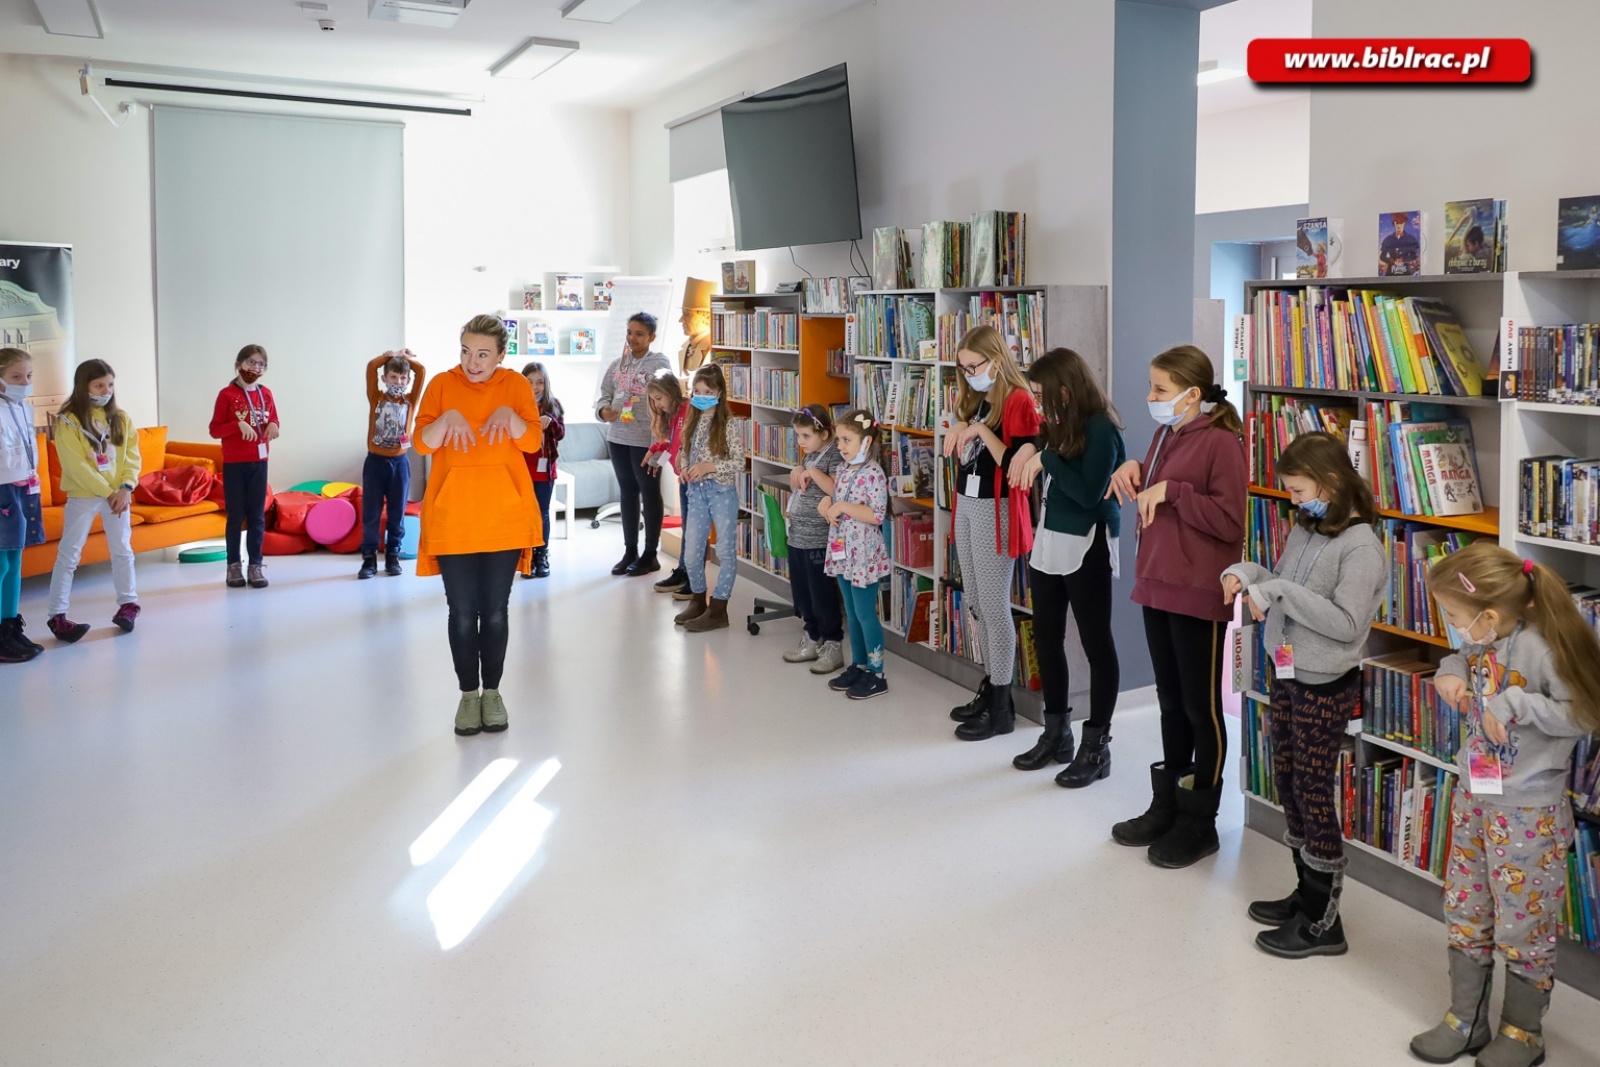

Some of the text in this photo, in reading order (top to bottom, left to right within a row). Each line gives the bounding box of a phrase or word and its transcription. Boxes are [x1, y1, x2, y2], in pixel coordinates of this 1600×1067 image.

[0, 258, 21, 269] ary
[889, 383, 898, 413] ROŚLINY
[1353, 450, 1361, 471] NEK
[1422, 450, 1437, 485] MANGA
[1441, 469, 1472, 480] MANGA
[1235, 631, 1243, 669] SPORT
[1403, 815, 1412, 861] HOBBY
